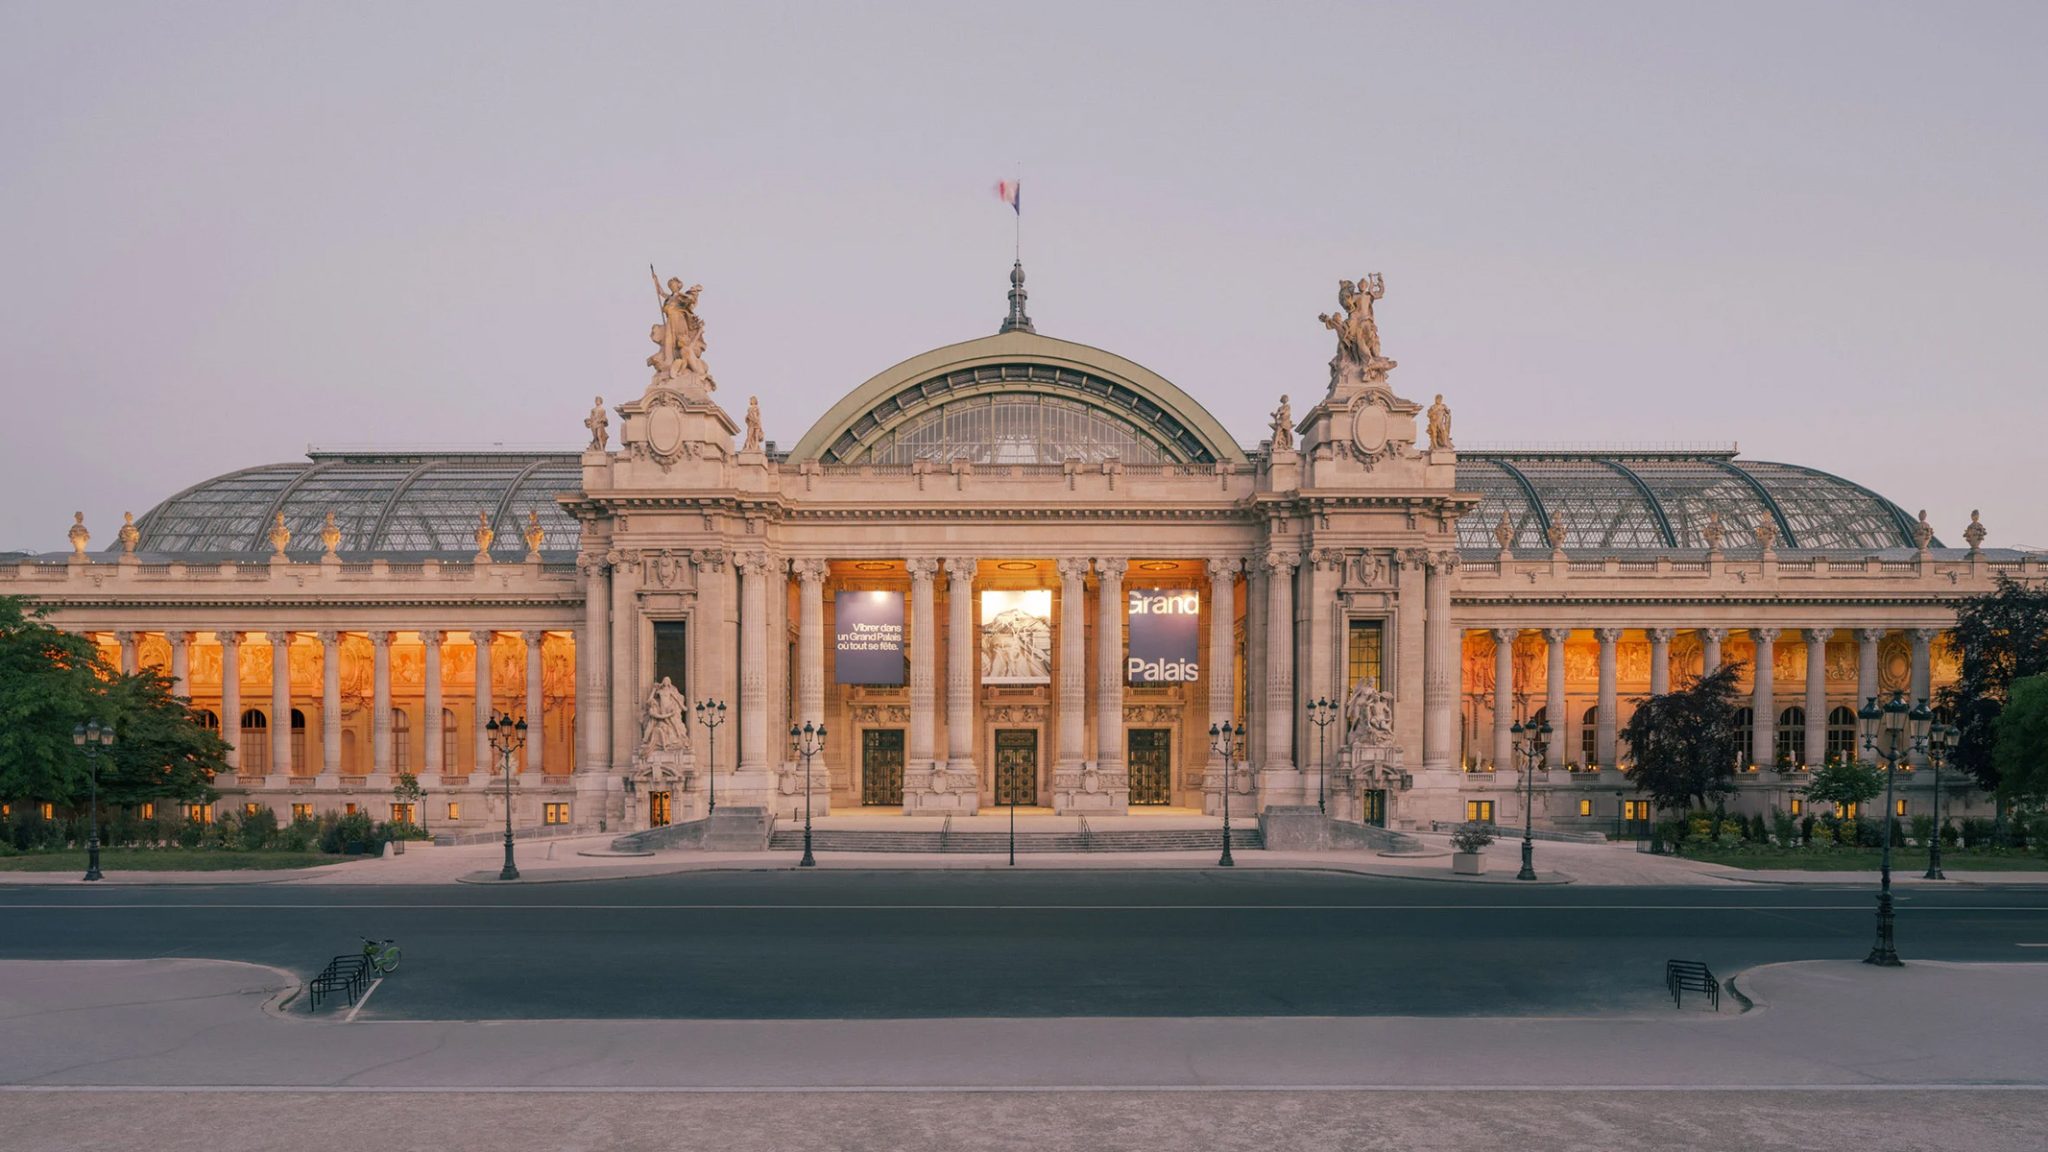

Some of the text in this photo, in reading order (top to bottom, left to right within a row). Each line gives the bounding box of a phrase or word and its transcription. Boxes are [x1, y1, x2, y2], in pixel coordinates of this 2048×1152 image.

[1128, 590, 1200, 615] Grand
[852, 623, 902, 632] Vibrer dans
[837, 632, 902, 641] un Grand Palais
[837, 641, 899, 650] où tout se fête.
[1128, 657, 1199, 681] Palais
